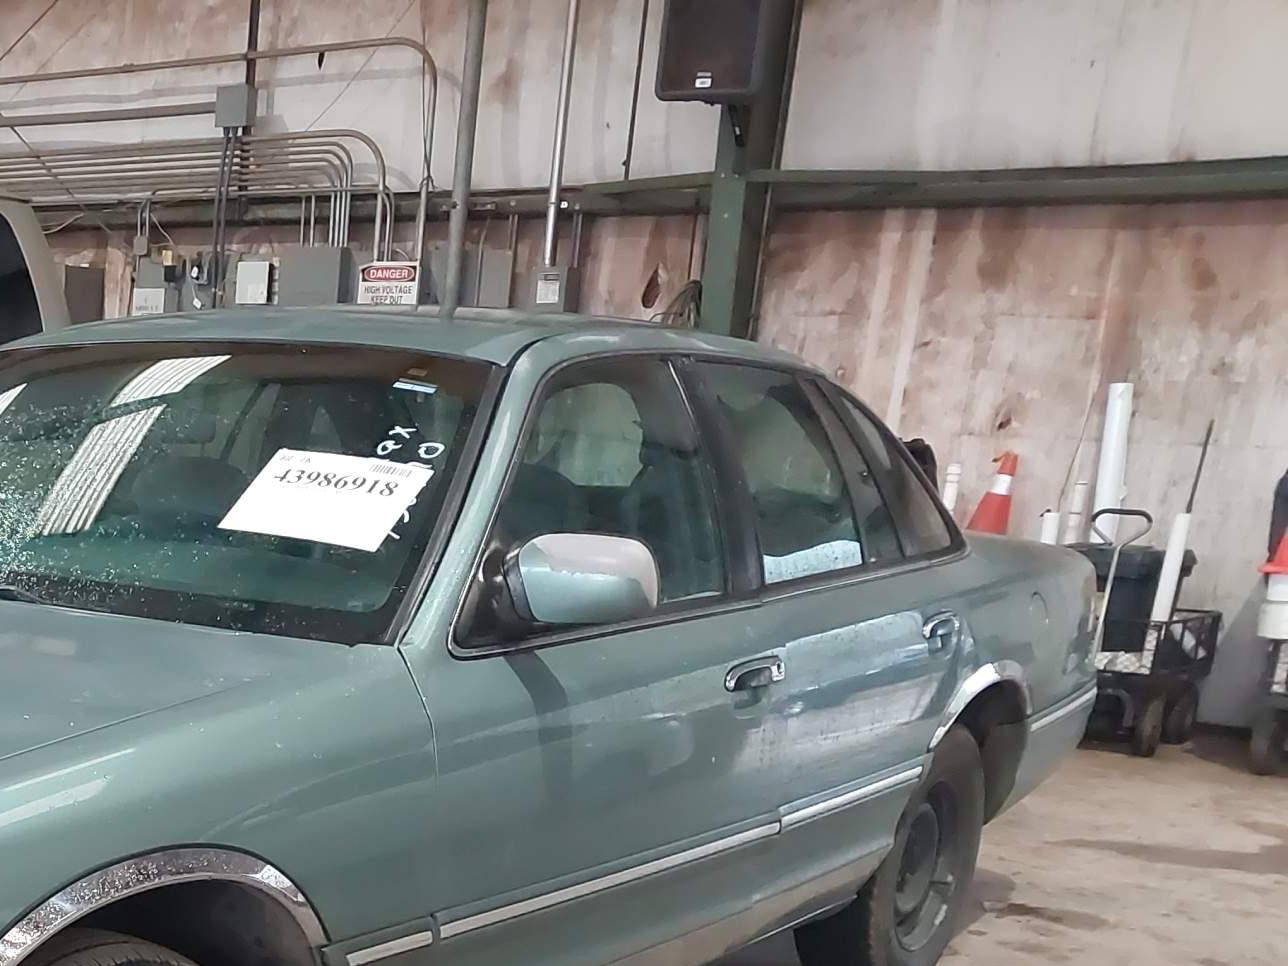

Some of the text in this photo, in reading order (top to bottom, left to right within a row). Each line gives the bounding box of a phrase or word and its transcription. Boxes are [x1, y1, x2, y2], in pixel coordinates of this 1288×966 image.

[369, 269, 409, 279] DANGER
[364, 285, 413, 295] HIGH VOLTAGE
[274, 468, 400, 497] 43986918
